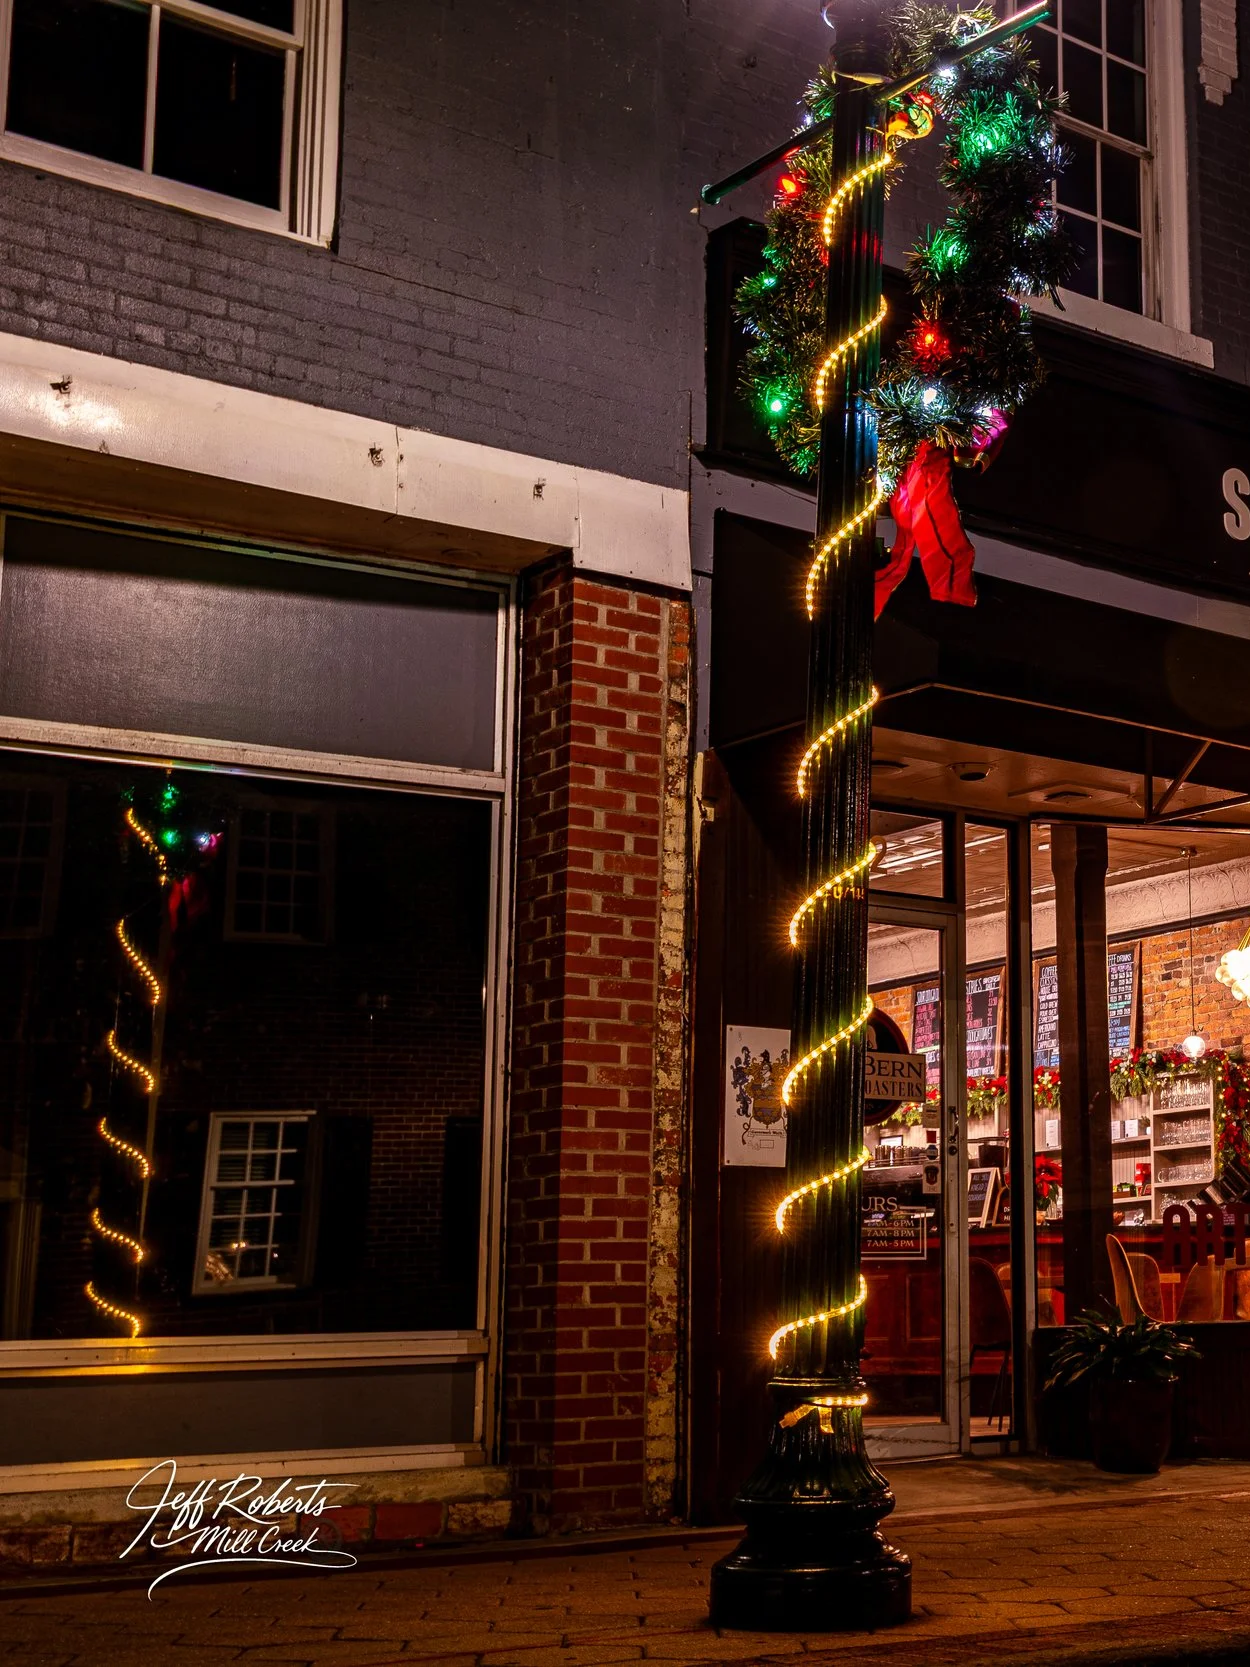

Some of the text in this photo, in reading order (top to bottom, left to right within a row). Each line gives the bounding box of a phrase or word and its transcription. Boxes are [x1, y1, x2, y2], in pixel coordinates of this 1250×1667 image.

[865, 1056, 924, 1079] BERN
[865, 1080, 923, 1097] OASTERS
[861, 1197, 898, 1211] URS
